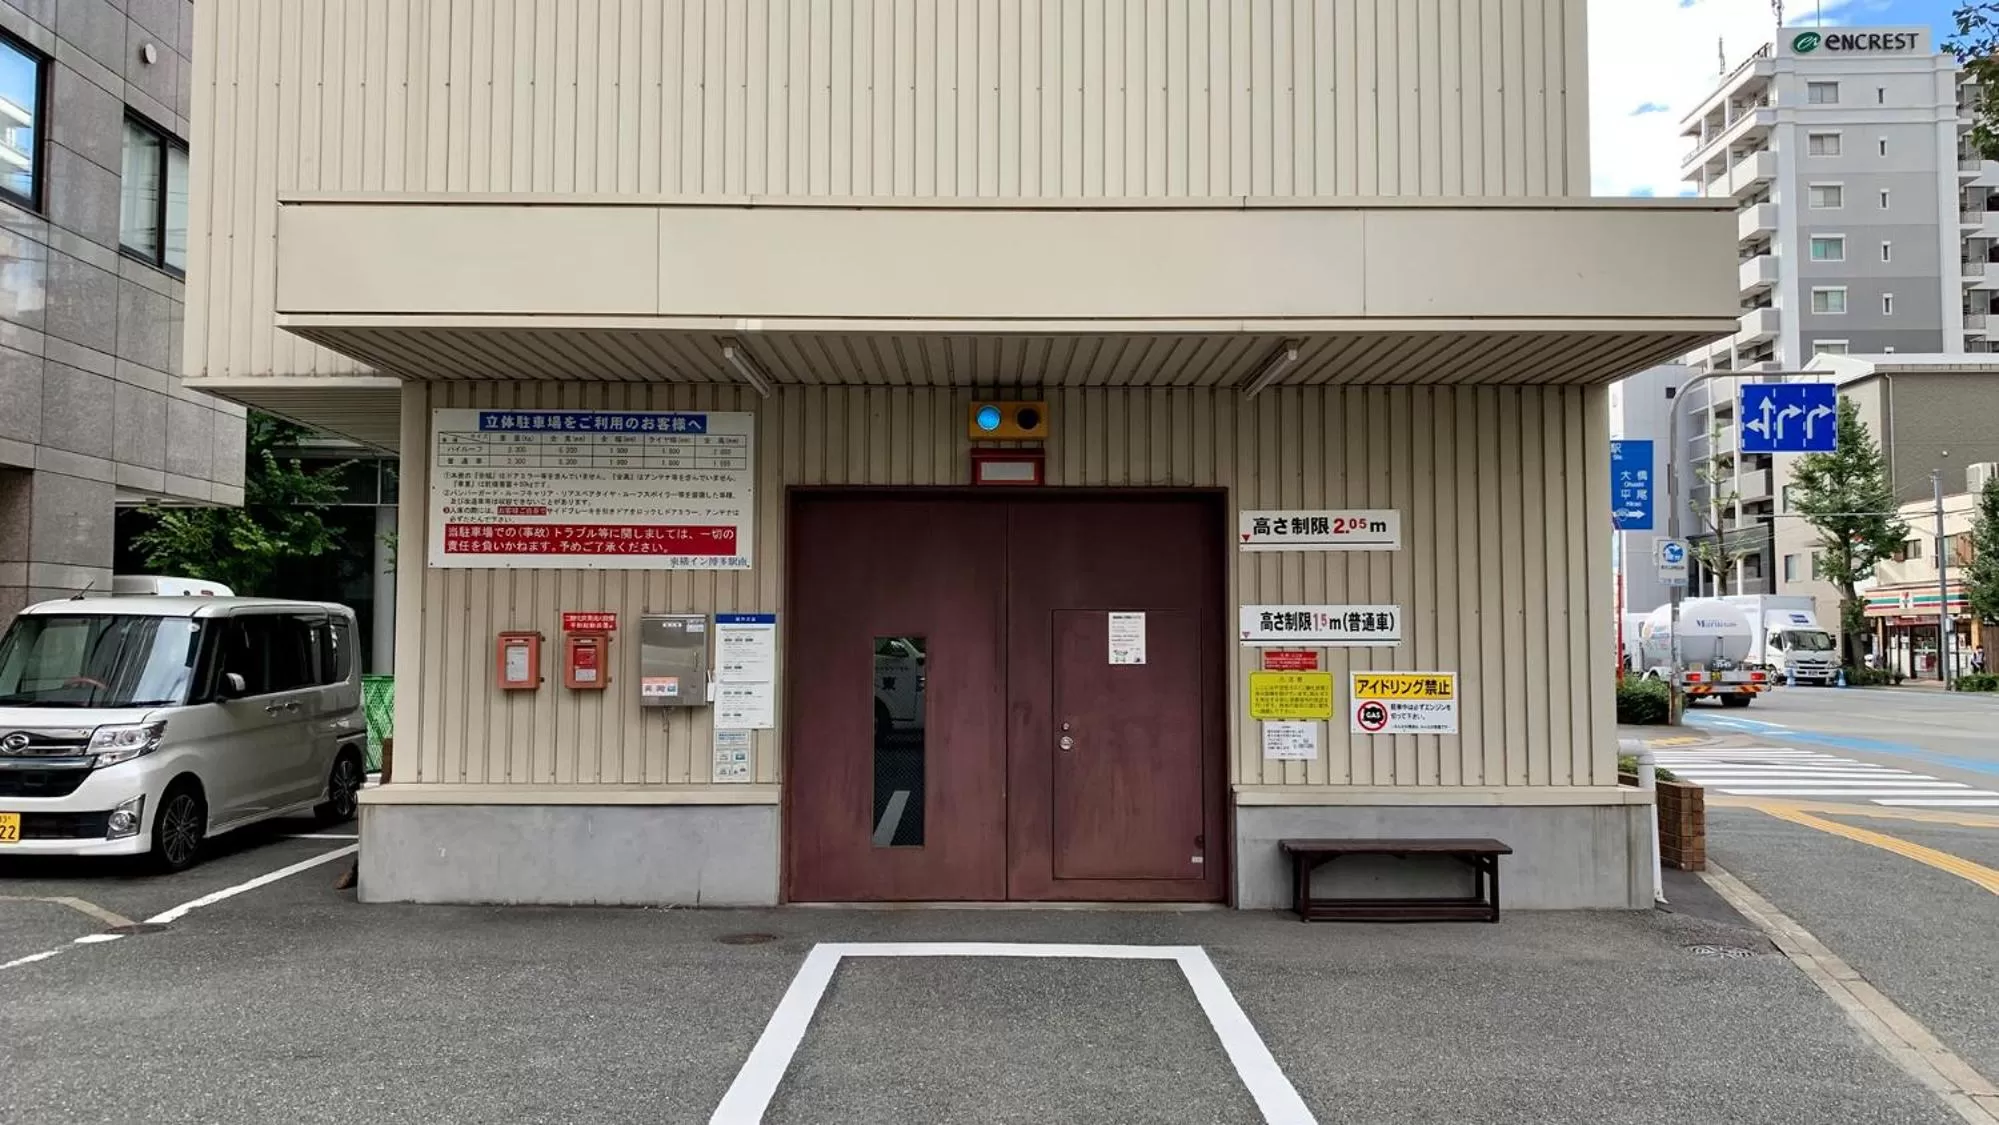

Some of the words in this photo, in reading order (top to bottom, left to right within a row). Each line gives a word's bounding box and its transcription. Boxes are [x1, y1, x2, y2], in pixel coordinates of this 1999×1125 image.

[485, 416, 702, 431] 立体駐車場をご利用のお客様へ
[1357, 679, 1450, 697] アイドリング禁止
[1365, 710, 1382, 719] GAS
